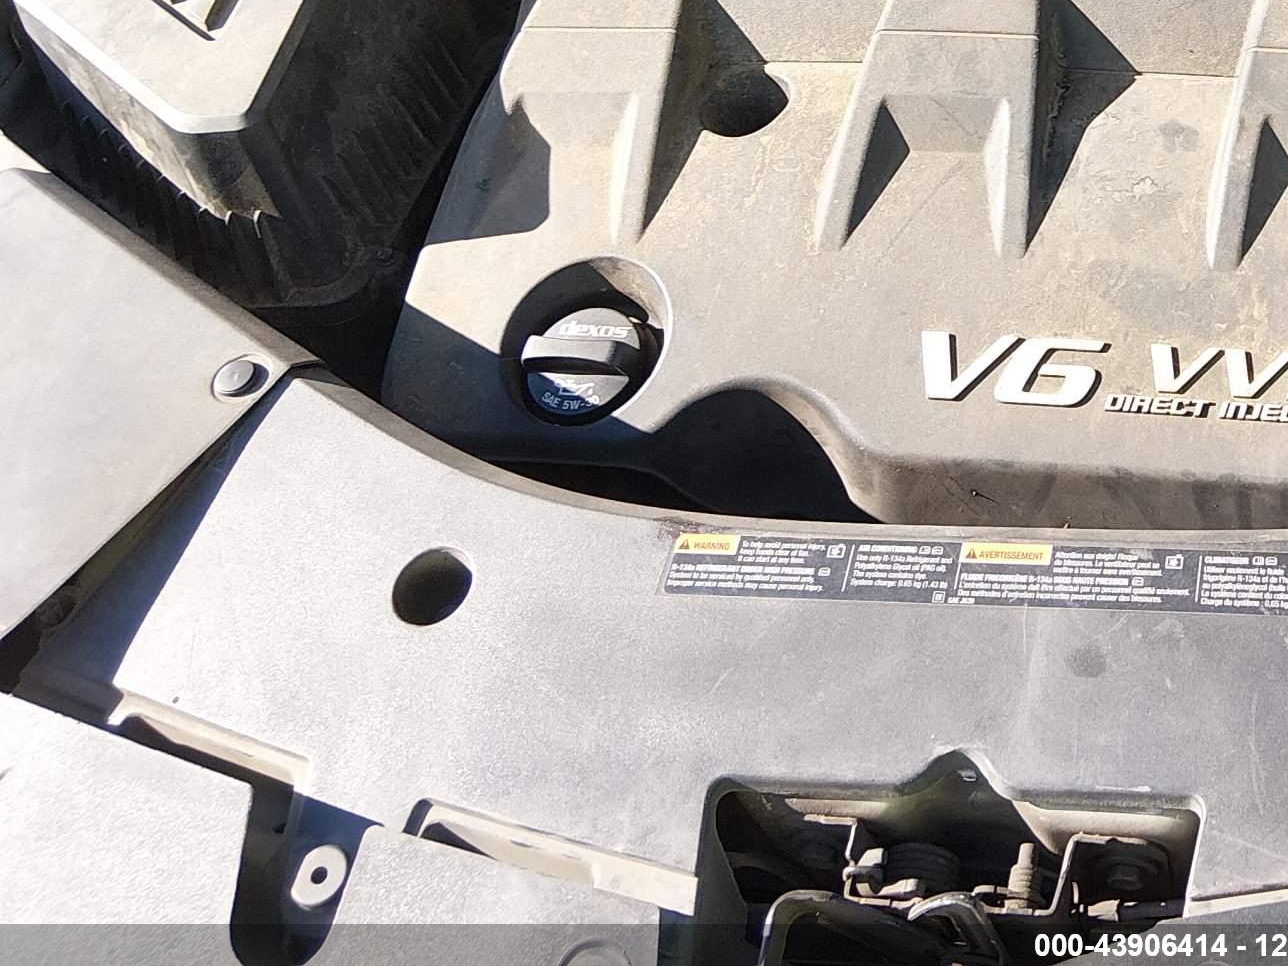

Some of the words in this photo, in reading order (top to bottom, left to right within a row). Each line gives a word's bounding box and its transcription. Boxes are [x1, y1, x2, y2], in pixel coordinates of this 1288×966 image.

[558, 320, 634, 338] dexos
[921, 330, 1112, 408] V6
[541, 392, 562, 409] SAE
[562, 394, 600, 410] 5W-30
[1104, 393, 1216, 418] DIRECT
[693, 542, 730, 550] WARNING
[979, 551, 1043, 560] AVERTISSEMENT
